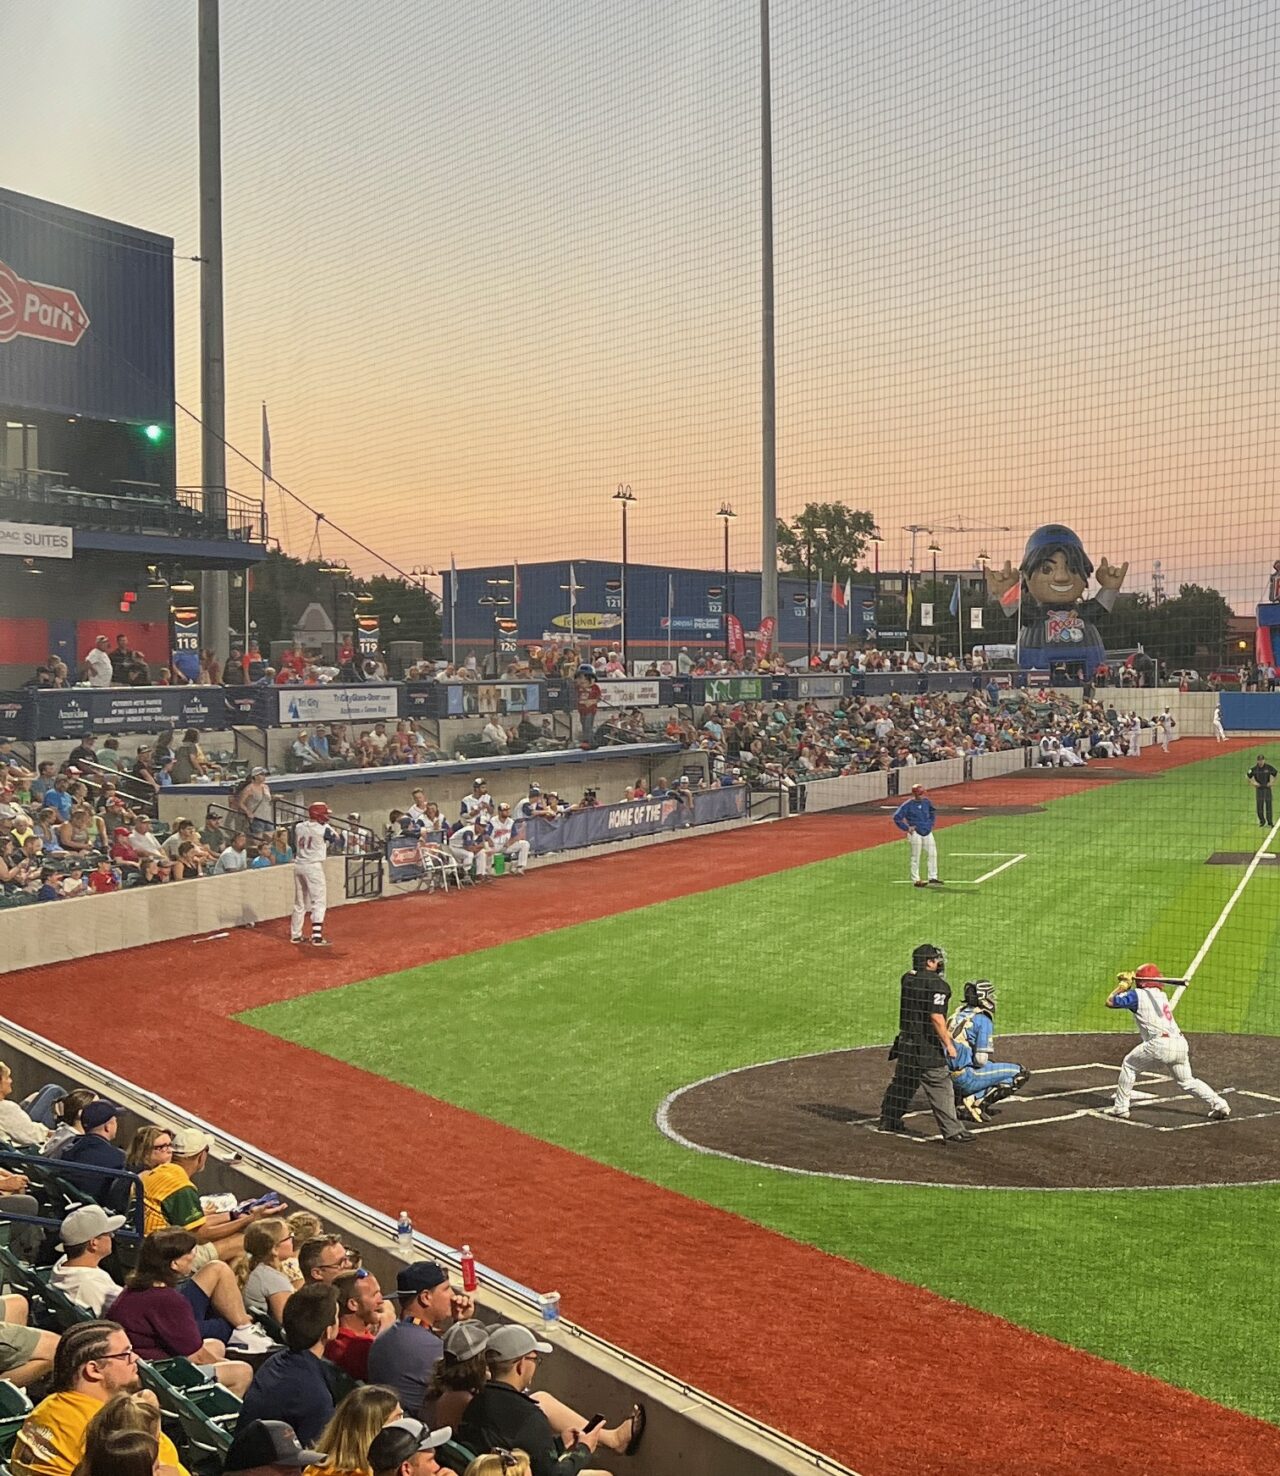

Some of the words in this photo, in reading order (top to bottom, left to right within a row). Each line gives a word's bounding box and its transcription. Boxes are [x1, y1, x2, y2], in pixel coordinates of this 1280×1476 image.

[24, 293, 73, 332] Park
[24, 533, 68, 548] SUITES
[177, 638, 198, 649] 118
[360, 643, 378, 653] 119
[608, 807, 632, 829] HOME
[634, 805, 645, 825] OF
[645, 803, 661, 823] THE
